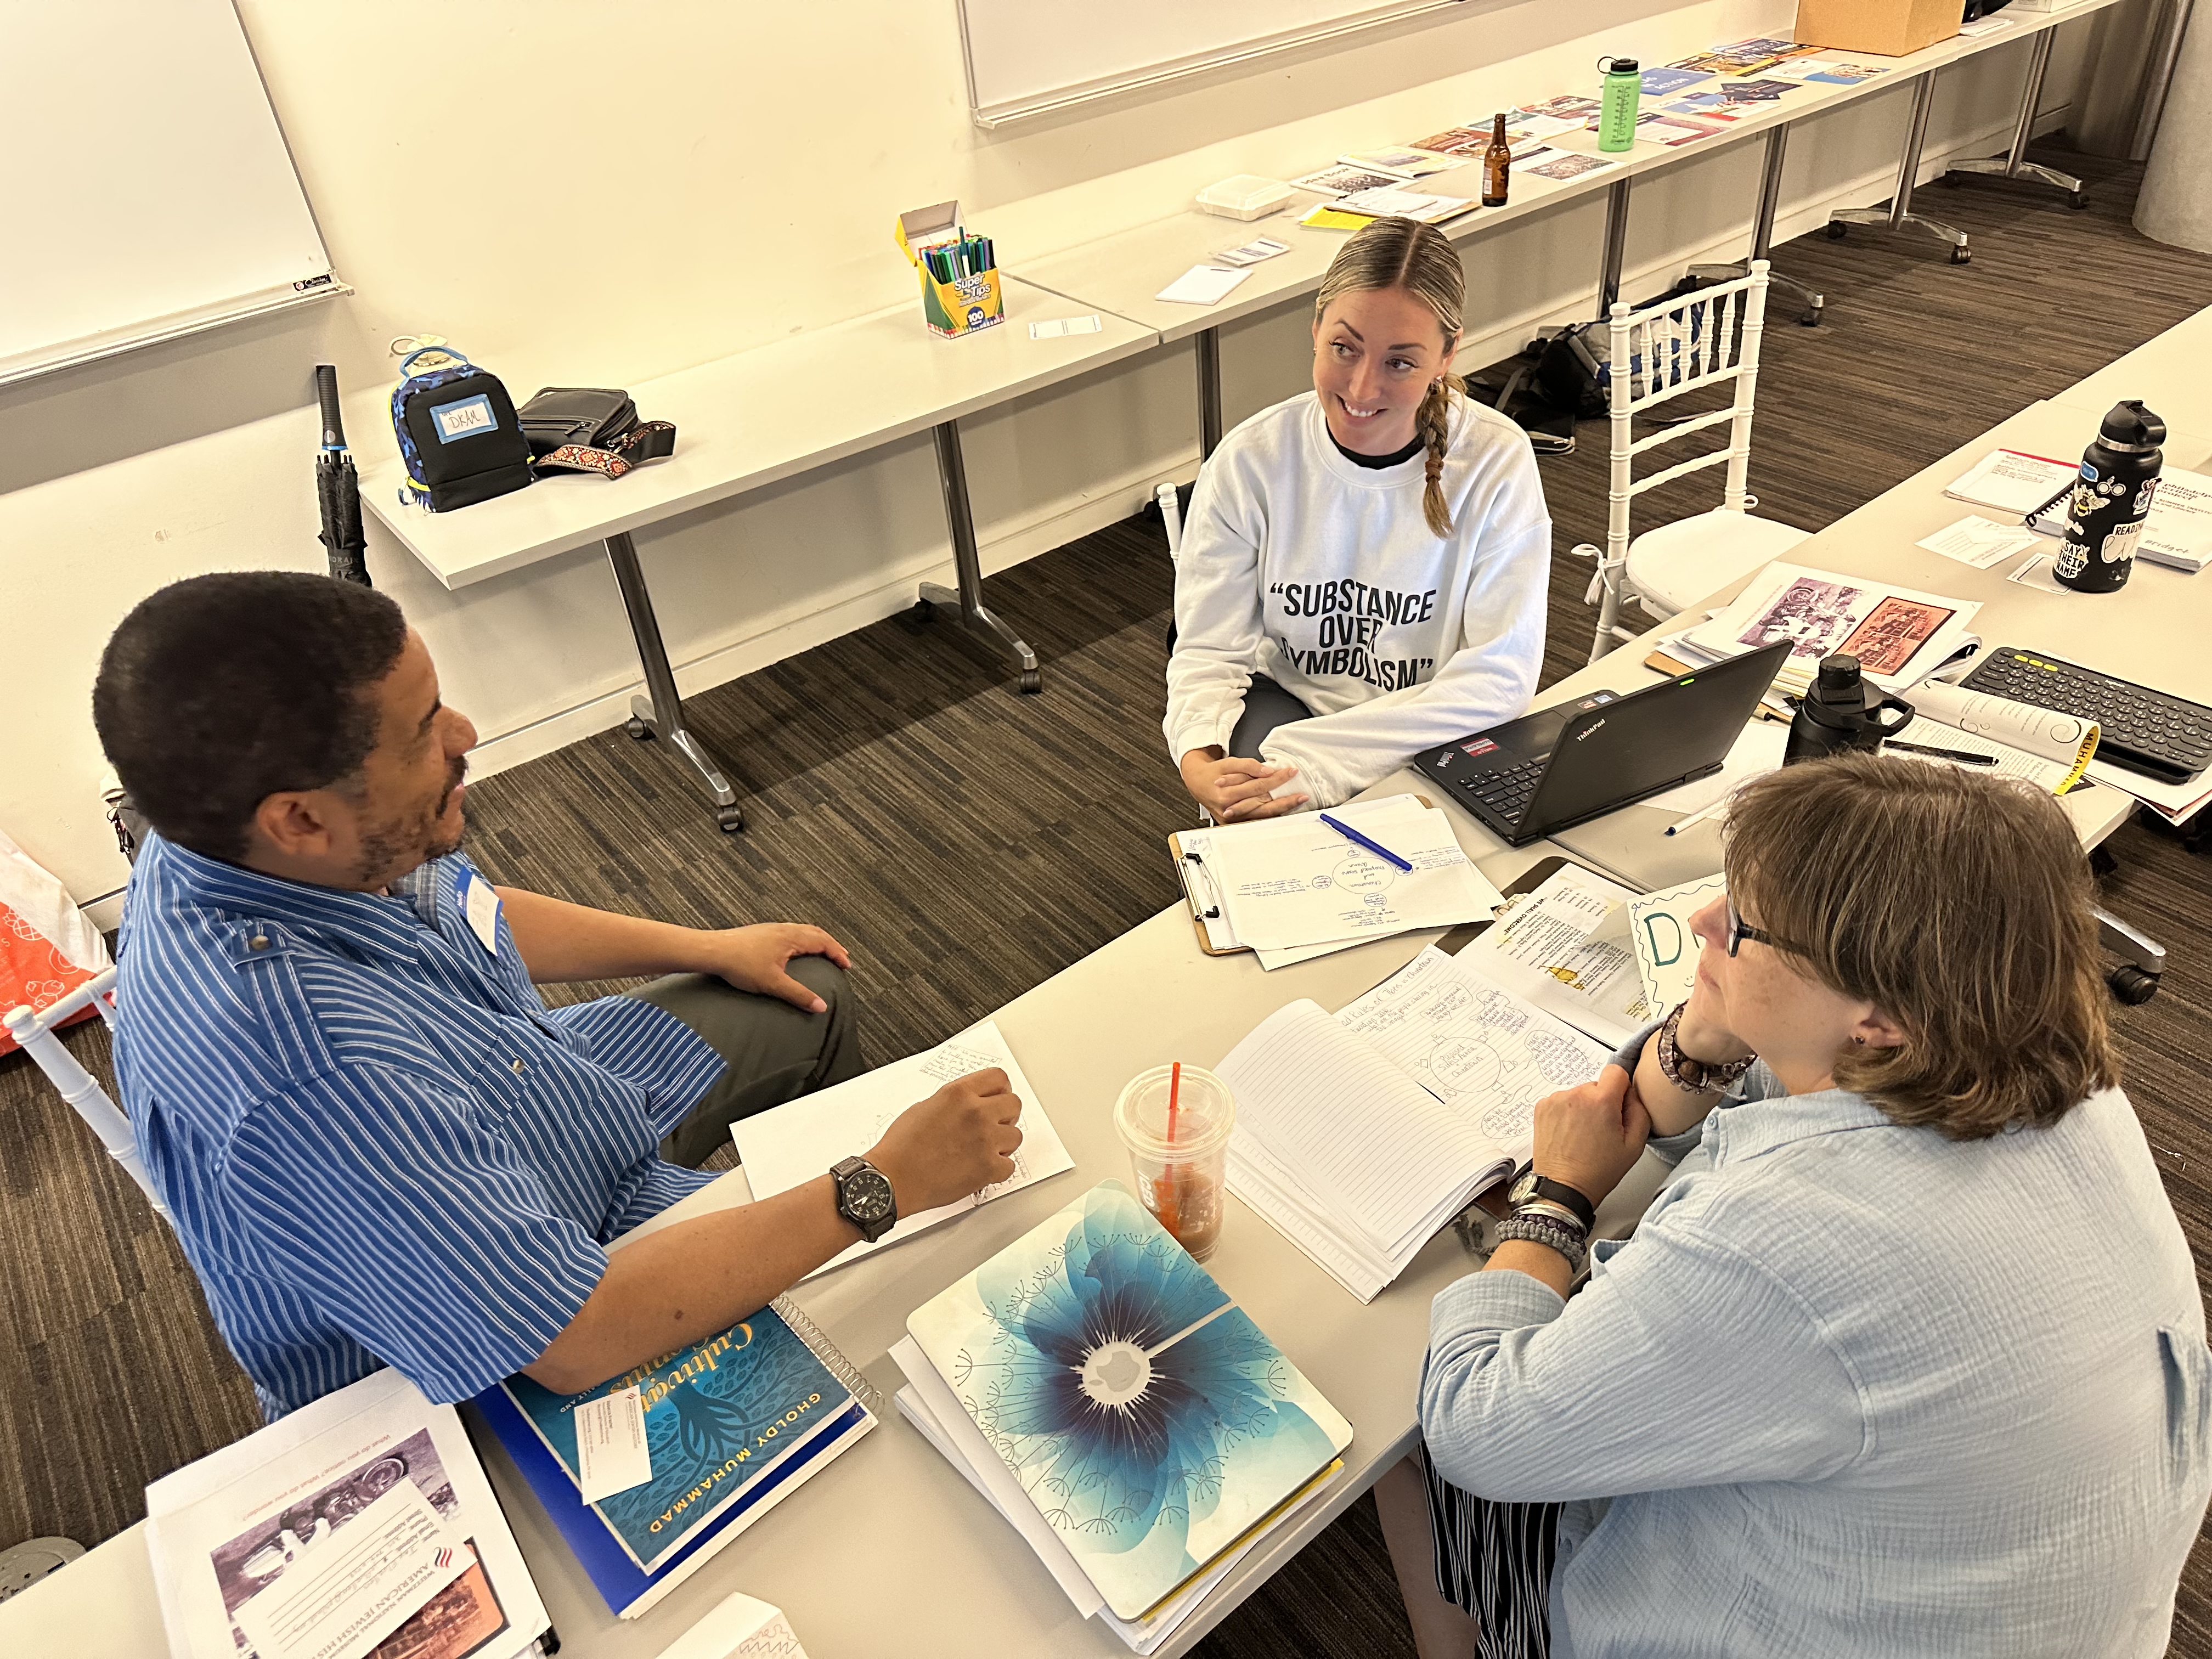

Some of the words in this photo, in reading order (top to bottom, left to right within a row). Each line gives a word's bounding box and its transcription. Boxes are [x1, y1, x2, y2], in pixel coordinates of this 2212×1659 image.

[955, 273, 984, 291] Super
[970, 283, 991, 297] Tips
[967, 311, 984, 322] 100
[2187, 506, 2212, 515] INSTITU
[1270, 578, 1437, 625] “SUBSTANCE
[1319, 614, 1383, 654] OVER
[1575, 718, 1606, 742] ThinkPad
[1525, 902, 1538, 915] SHALL
[642, 1323, 753, 1415] Cultivat
[758, 1392, 822, 1447] GHOLDY
[650, 1447, 752, 1533] MUHAMMAD
[374, 1562, 430, 1610] AMERICAN
[335, 1607, 375, 1643] JEWISH
[311, 1640, 336, 1659] HIS
